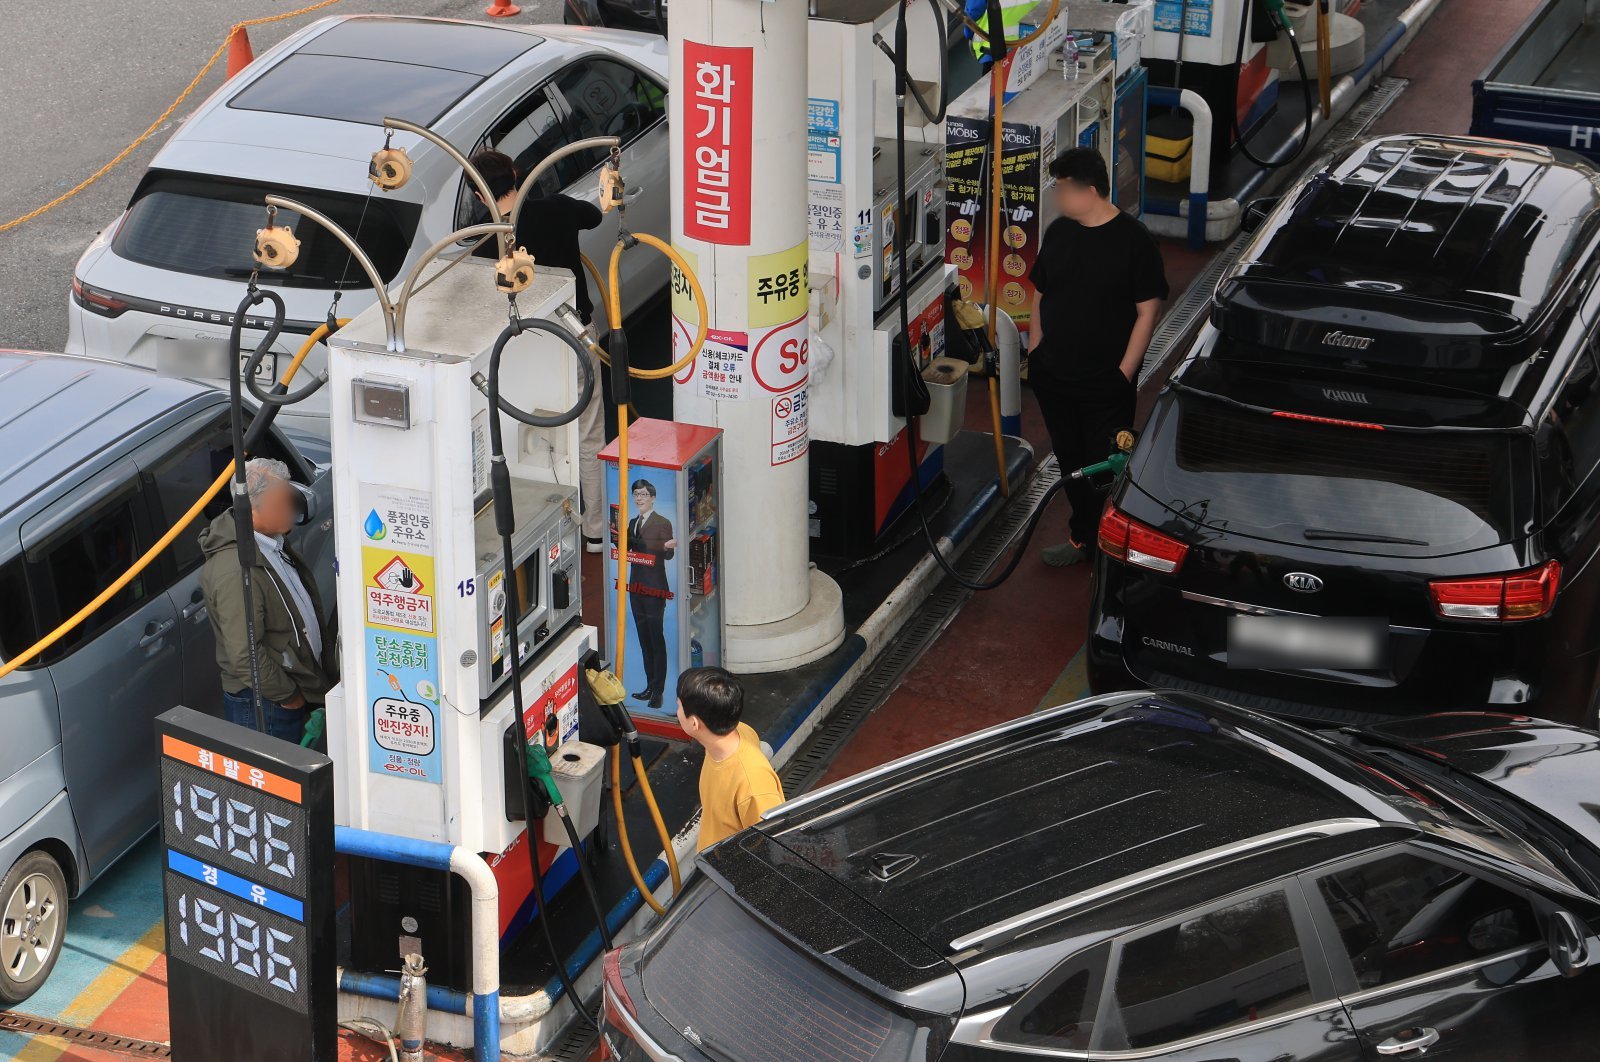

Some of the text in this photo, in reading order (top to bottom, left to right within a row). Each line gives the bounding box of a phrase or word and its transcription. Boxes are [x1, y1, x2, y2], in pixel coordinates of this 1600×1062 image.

[947, 126, 979, 139] MOBIS
[1570, 125, 1600, 149] H
[695, 61, 735, 229] 화기엄금
[1010, 190, 1035, 202] 첨가제
[858, 208, 871, 225] 11
[959, 198, 980, 216] UP
[1011, 205, 1033, 222] UP
[757, 268, 800, 305] 주유중
[160, 305, 275, 327] PORSCHE
[701, 348, 744, 362] 신용(체크)카드
[702, 369, 742, 384] 금액환불 안내
[708, 360, 736, 373] 결제 오류
[793, 385, 808, 413] 금연
[387, 510, 431, 529] 품질인증
[392, 525, 426, 541] 주유소
[457, 577, 475, 598] 15
[1289, 575, 1317, 590] KIA
[370, 591, 429, 612] 역주행금지
[374, 635, 427, 658] 탄소중립
[1141, 636, 1195, 657] CARNIVAL
[375, 651, 428, 671] 실천하기
[385, 704, 421, 723] 주유중
[377, 717, 429, 738] 엔진정지!
[173, 780, 296, 879] 1986
[178, 893, 298, 994] 1986
